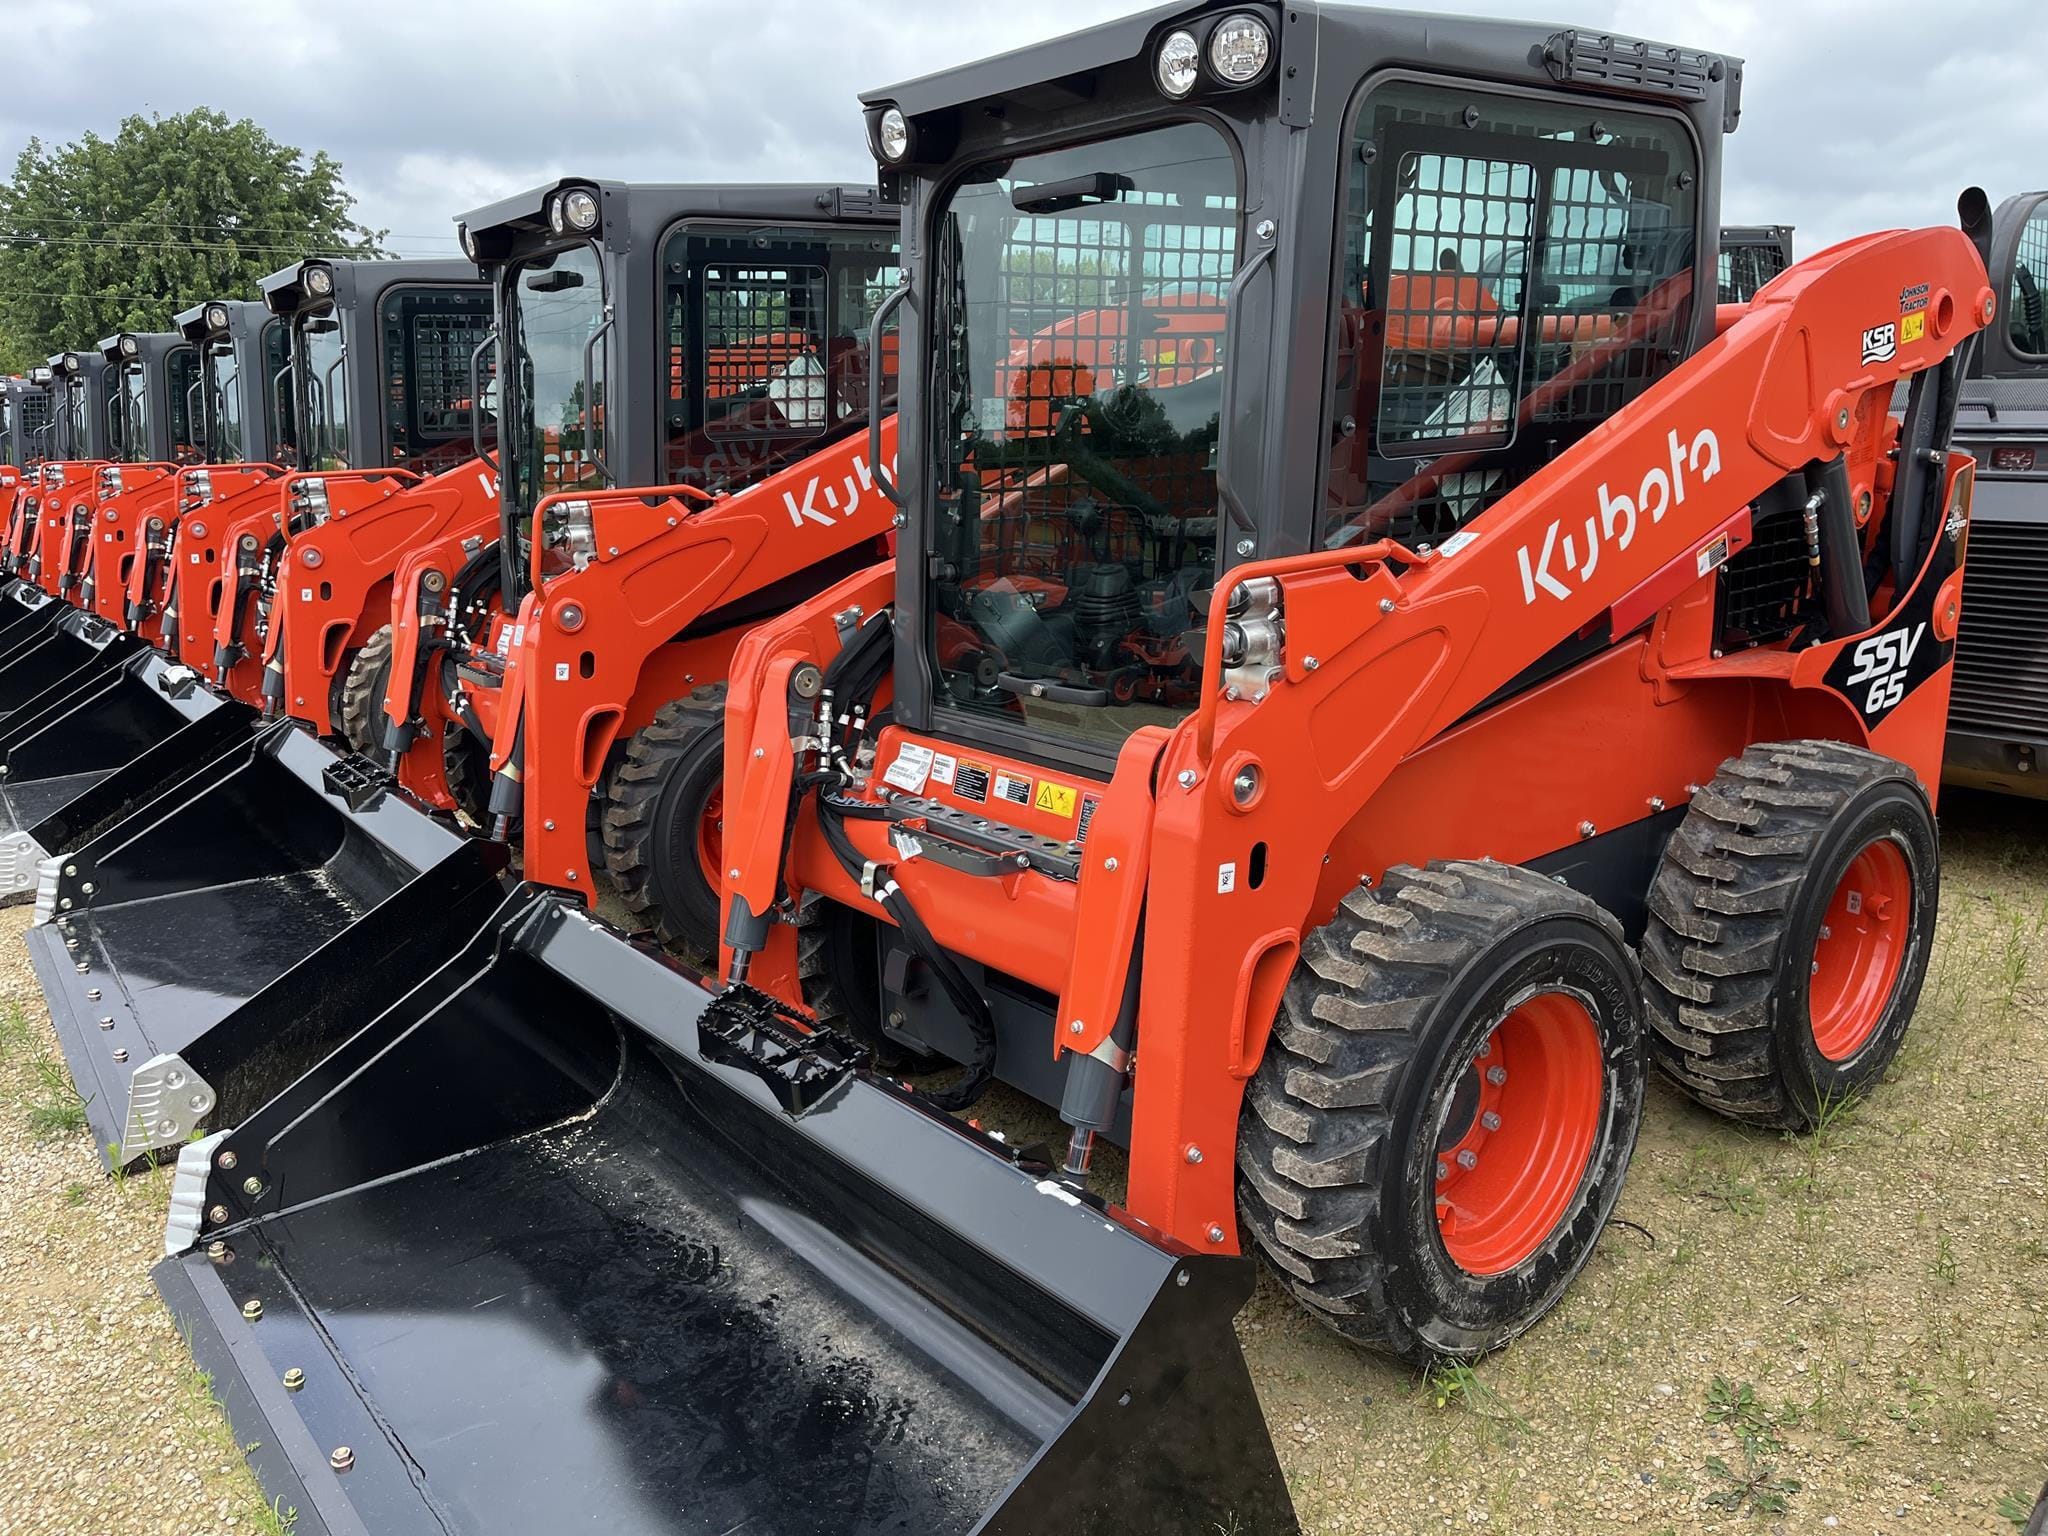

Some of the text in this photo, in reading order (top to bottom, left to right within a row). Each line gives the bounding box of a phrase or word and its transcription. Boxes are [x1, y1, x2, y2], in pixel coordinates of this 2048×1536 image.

[1899, 283, 1930, 300] JOHNSON
[1899, 297, 1928, 313] TRACTOR
[1863, 323, 1896, 351] KSR
[1517, 428, 1721, 605] Kubota
[1846, 621, 1927, 686] SSV
[1865, 669, 1908, 714] 65
